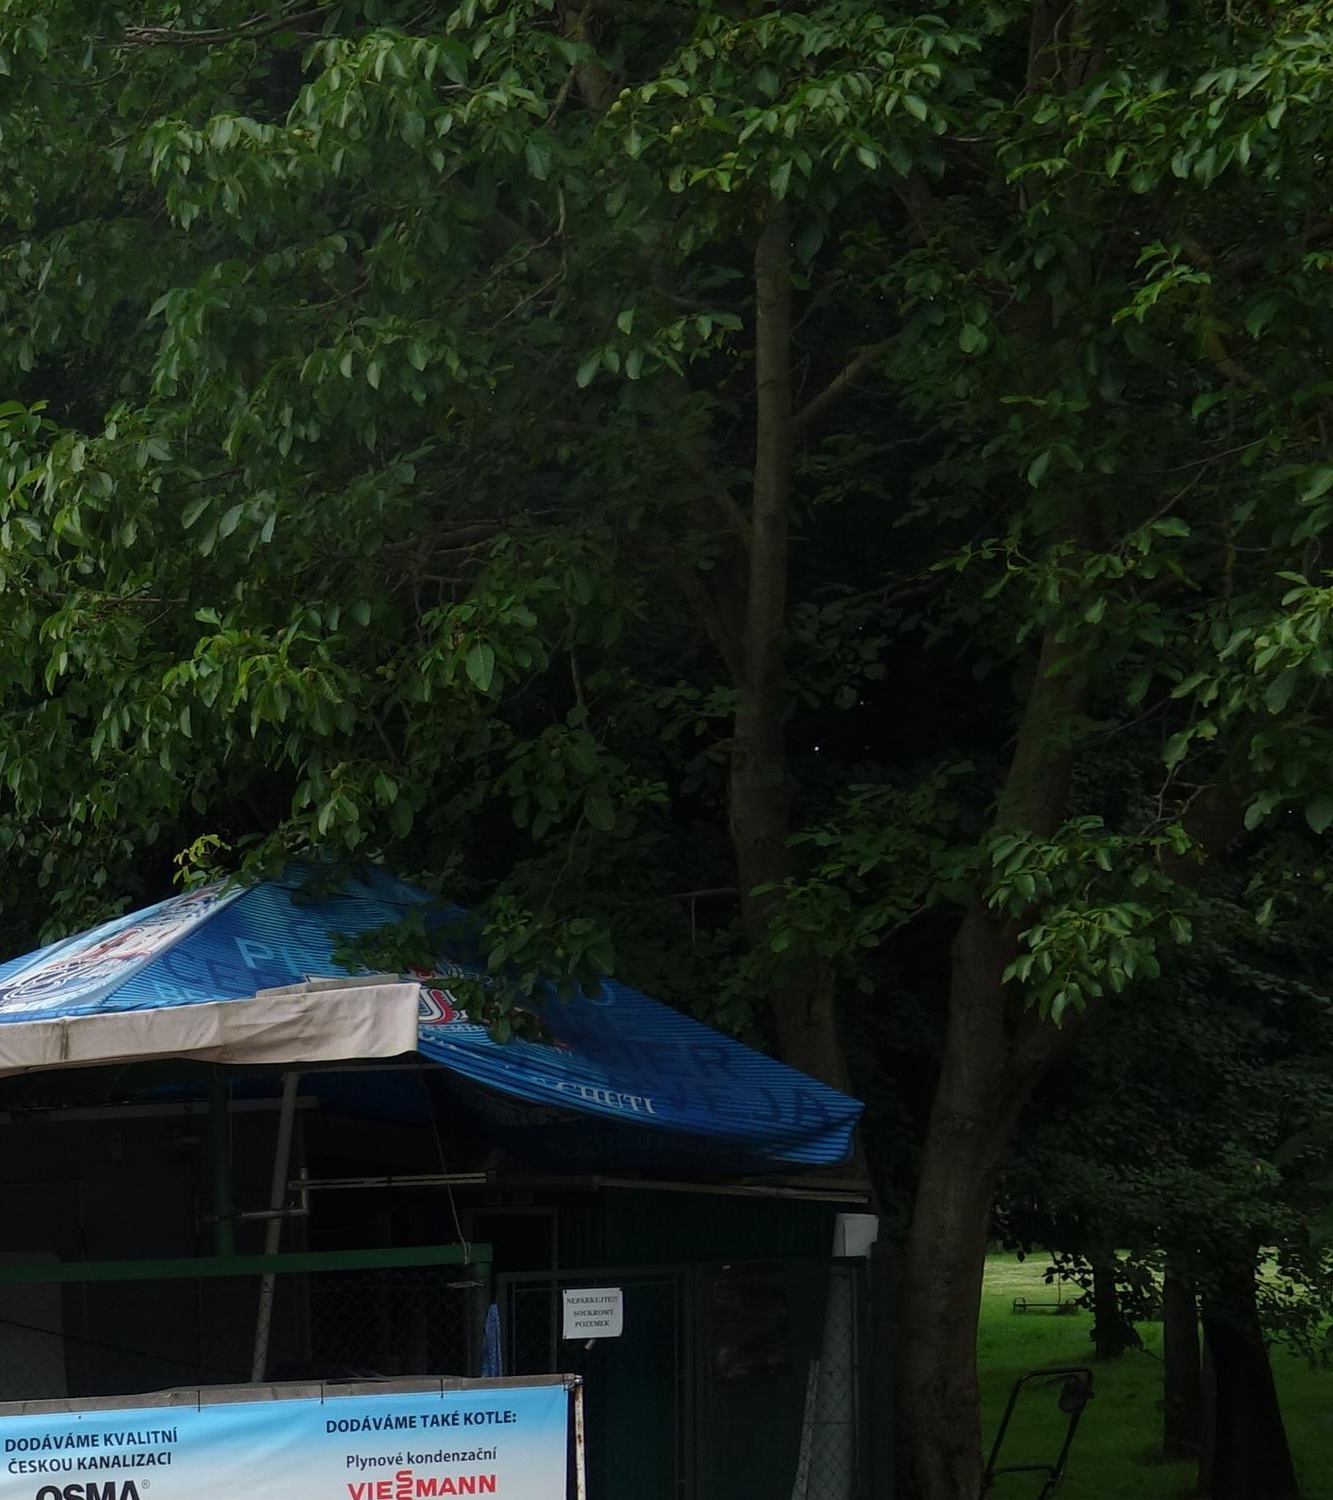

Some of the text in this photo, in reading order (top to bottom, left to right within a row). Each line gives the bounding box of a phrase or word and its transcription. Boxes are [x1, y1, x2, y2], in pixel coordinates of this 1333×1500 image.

[326, 1410, 517, 1433] DODÁVÁME TAKÉ KOTLE:
[4, 1427, 178, 1453] DODÁVÁME KVALITNÍ
[8, 1452, 172, 1474] ČESKOU KANALIZACI
[346, 1446, 497, 1471] Plynové kondenzační
